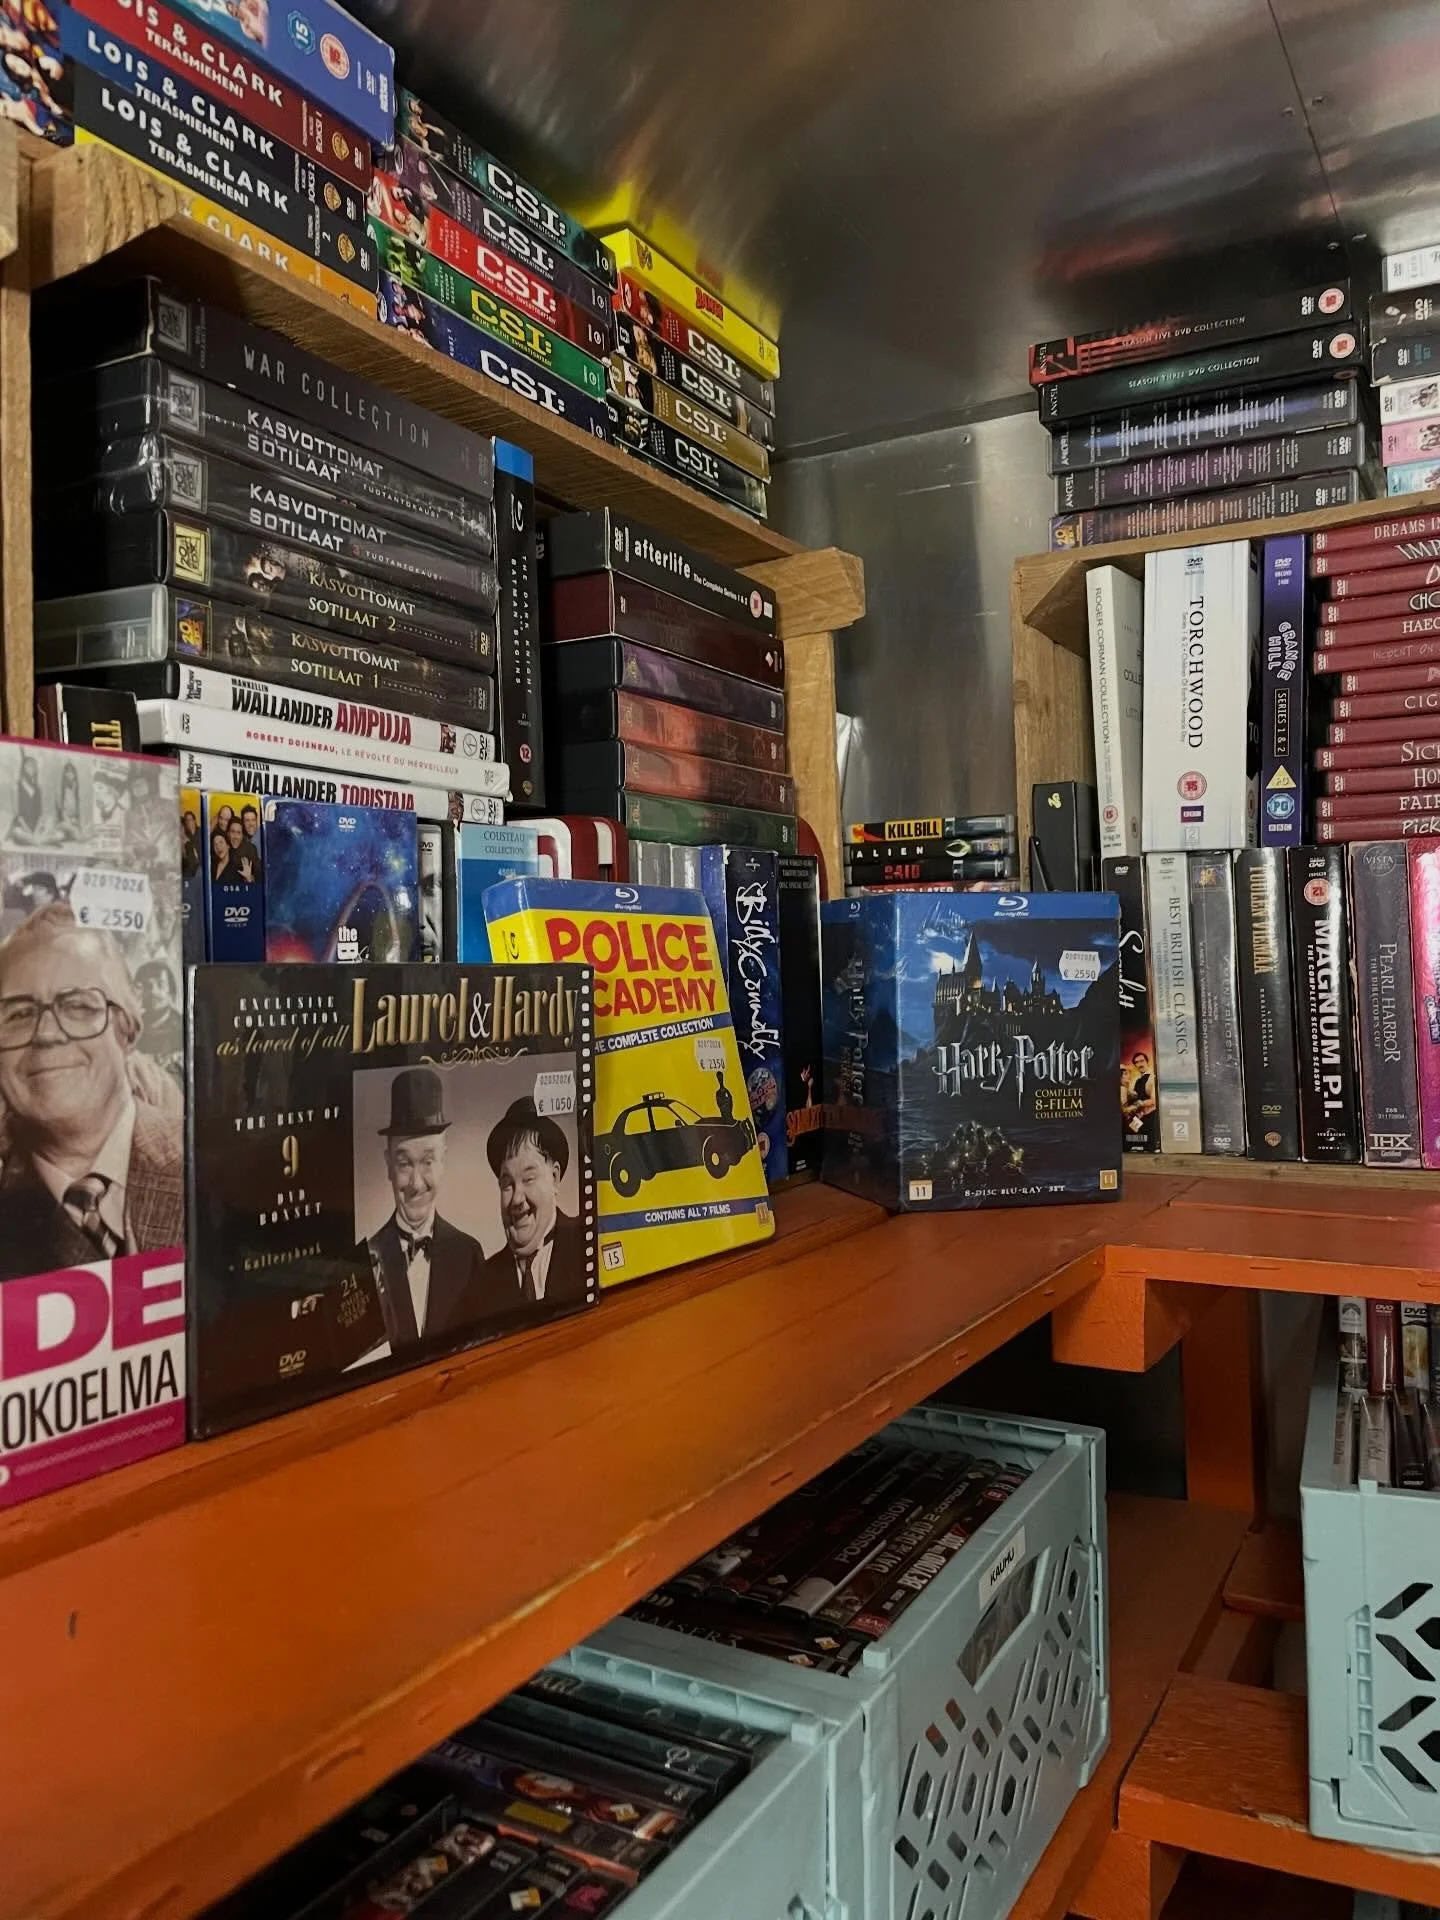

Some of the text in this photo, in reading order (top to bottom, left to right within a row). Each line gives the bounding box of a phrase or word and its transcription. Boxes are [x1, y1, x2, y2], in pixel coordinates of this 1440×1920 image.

[145, 27, 245, 100] TERÄSMIEHENI
[172, 23, 284, 108] & CLARK
[87, 29, 149, 82] LOIS
[162, 77, 179, 100] &
[191, 95, 275, 160] CLARK
[134, 82, 236, 152] TERÄSMIEHENI
[101, 88, 290, 215] LOIS & CLARK
[148, 139, 250, 209] TERÄSMIEHENI
[487, 163, 567, 238] CSI:
[205, 214, 290, 272] CLARK
[482, 207, 555, 271] CSI:
[476, 245, 557, 314] CSI:
[471, 289, 552, 358] CSI:
[1121, 336, 1152, 349] SEASON
[1174, 327, 1192, 338] DVD
[1194, 315, 1247, 334] COLLECTION
[480, 349, 566, 416] CSI:
[1128, 375, 1159, 389] SEASON
[1188, 366, 1206, 378] DVD
[1207, 355, 1261, 374] COLLECTION
[243, 344, 430, 450] WAR COLLECTION
[675, 399, 727, 443] CSI:
[246, 408, 385, 480] KASVOTTOMAT
[246, 434, 342, 485] SOTILAAT
[675, 437, 720, 480] CSI:
[249, 482, 388, 545] KASVOTTOMAT
[249, 507, 345, 554] SOTILAAT
[1374, 519, 1426, 539] DREAMS
[633, 537, 692, 580] afterlife
[308, 569, 417, 617] KASVOTTOMAT
[1095, 587, 1104, 627] ROGER
[308, 595, 398, 632] SOTILAAT 2
[289, 631, 401, 673] KASVOTTOMAT
[1097, 627, 1107, 675] CORMAN
[1267, 635, 1283, 671] HILL
[1278, 621, 1299, 681] GRANGE
[231, 677, 269, 693] MANKELLIN
[290, 657, 380, 689] SOTILAAT 1
[1187, 595, 1205, 749] TORCHWOOD
[231, 686, 334, 730] WALLANDER
[334, 701, 412, 746] AMPUJA
[1100, 676, 1110, 745] COLLECTION
[1276, 691, 1287, 724] SERIES
[245, 730, 285, 744] ROBERT
[288, 737, 339, 755] DOISNEAU,
[231, 759, 270, 772] MANKELLIN
[231, 768, 337, 804] WALLANDER
[1274, 800, 1290, 812] PG
[483, 830, 526, 843] COUSTEAU
[887, 819, 940, 840] KILL BILL
[1268, 823, 1293, 832] BBC
[484, 845, 526, 856] COLLECTION
[856, 845, 925, 859] ALIEN
[1365, 856, 1394, 866] VISTA
[223, 884, 241, 893] OSA
[884, 863, 921, 881] RAID
[79, 905, 145, 931] € 2550
[223, 906, 251, 918] DVD
[338, 924, 359, 943] the
[545, 917, 713, 974] POLICE
[1074, 969, 1097, 980] 2550
[1168, 895, 1189, 1056] BEST BRITISH CLASSICS
[1369, 957, 1378, 975] THE
[239, 995, 336, 1012] EXCLUSIVE
[594, 975, 717, 1018] CADEMY
[1314, 918, 1341, 1066] MAGNUM
[1379, 941, 1401, 1063] PEARL HARBOR
[232, 1010, 340, 1029] COLLECTION
[351, 974, 580, 1054] Laurel & Hardy
[1306, 943, 1321, 1094] THE COMPLETE SECOND SEASON
[607, 1030, 660, 1051] COMPLETE
[660, 1017, 715, 1040] COLLECTION
[1373, 1030, 1381, 1049] CUT
[931, 1034, 1096, 1110] Harry Potter
[550, 1096, 573, 1112] 1050
[1034, 1087, 1084, 1099] COMPLETE
[1034, 1098, 1084, 1111] 8-FILM
[1322, 1074, 1344, 1119] P.I.
[234, 1105, 340, 1132] THE BEST OF
[1034, 1109, 1084, 1120] COLLECTION
[281, 1134, 300, 1178] 9
[1371, 1134, 1412, 1149] THX
[914, 1186, 928, 1198] 11
[964, 1184, 1066, 1198] 8-DISC BLU-RAY SET
[258, 1201, 322, 1226] BOXSET
[644, 1209, 687, 1224] CONTAINS
[686, 1206, 702, 1219] ALL
[709, 1203, 731, 1217] FILMS
[278, 1350, 307, 1368] DVD
[0, 1348, 179, 1452] OKOELMA
[833, 1498, 915, 1564] POSSESSION
[989, 1547, 1015, 1586] KAUHU
